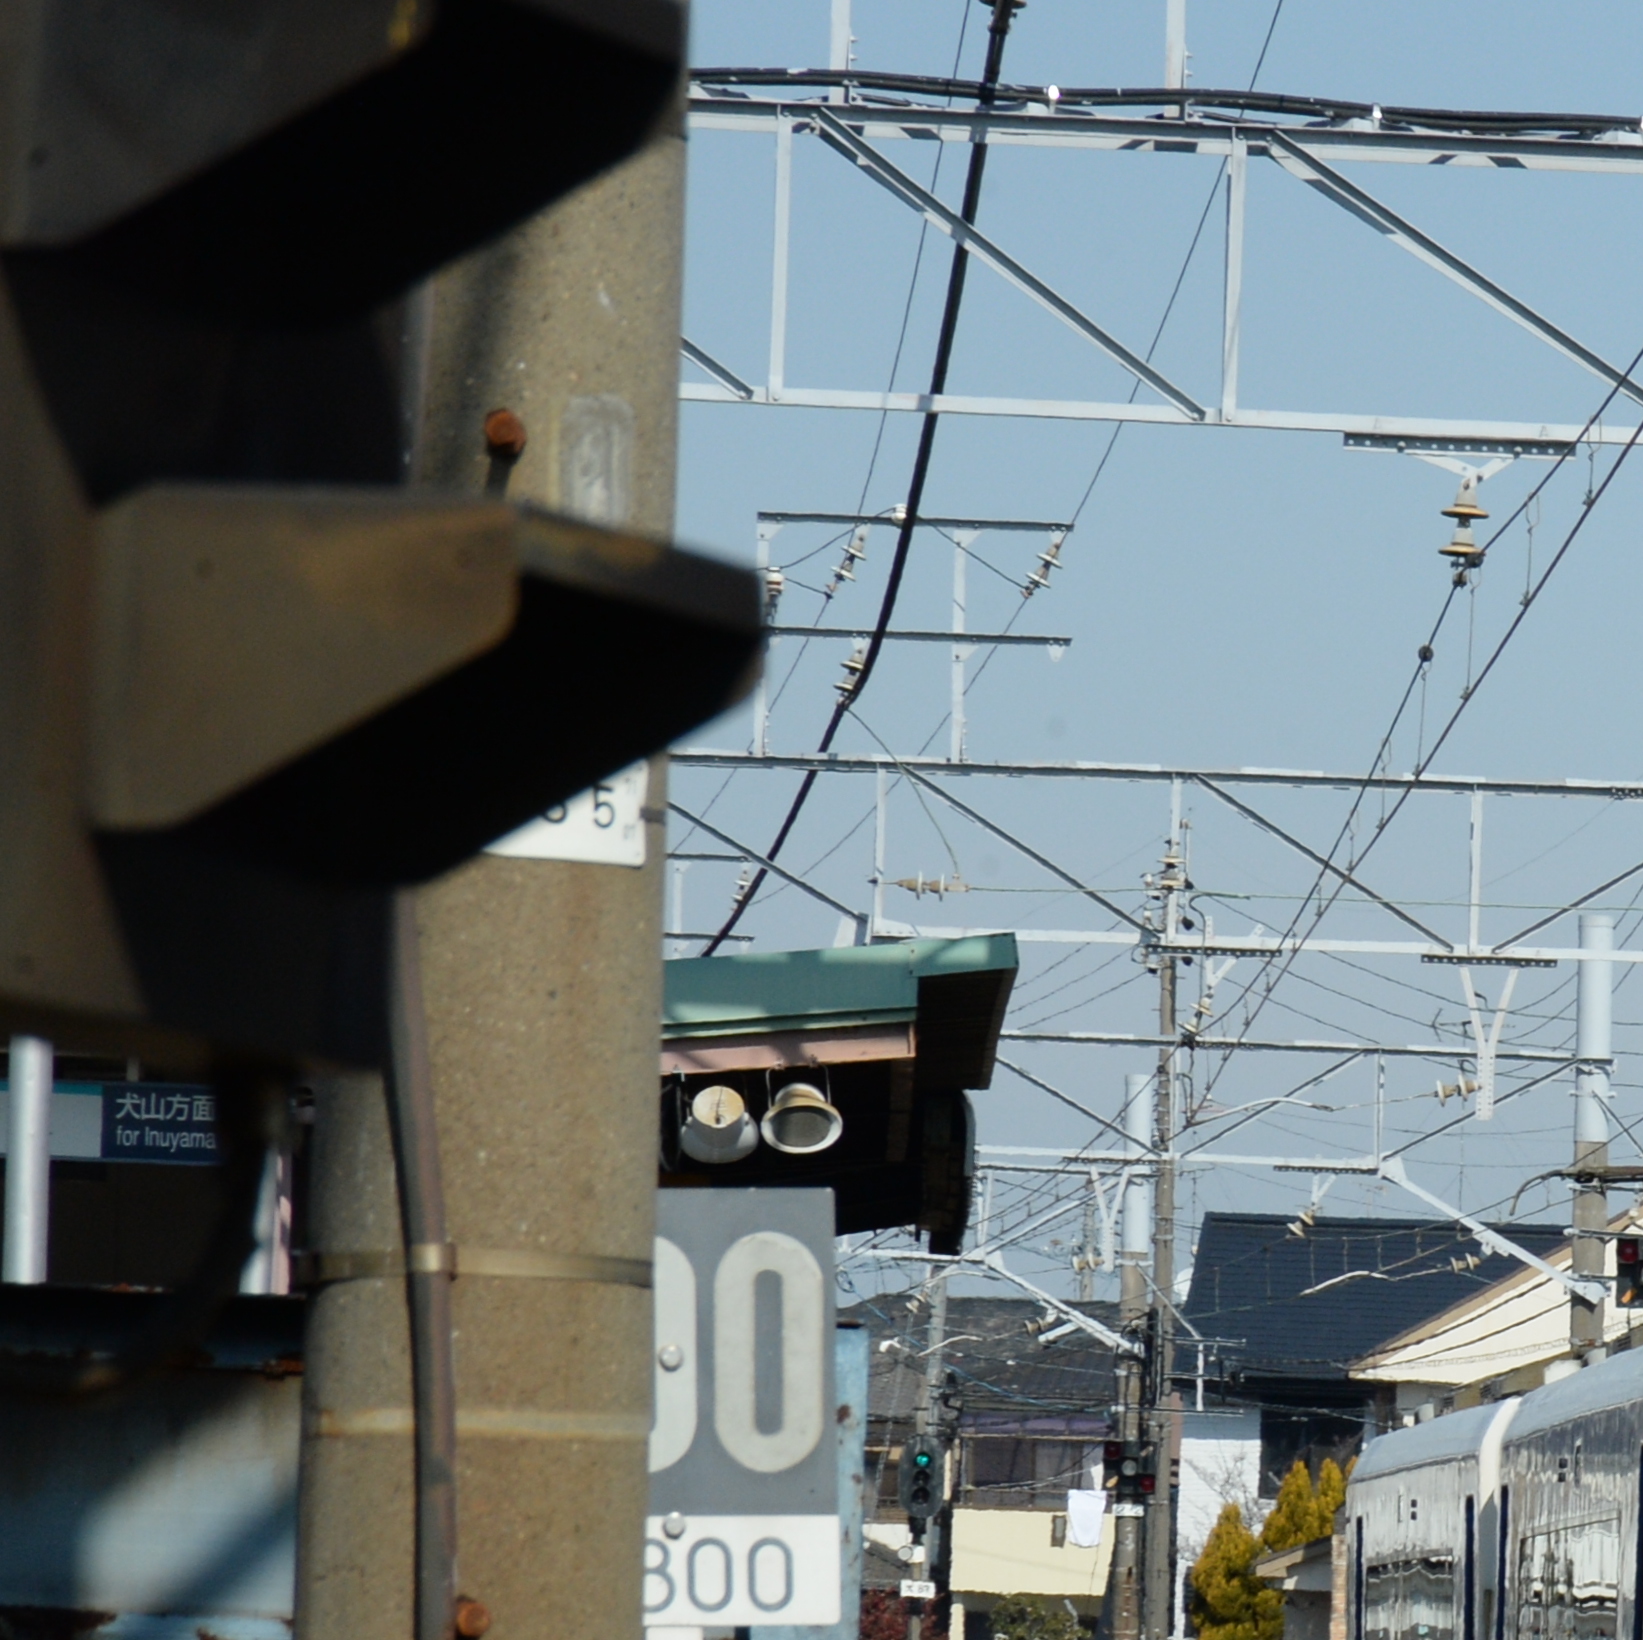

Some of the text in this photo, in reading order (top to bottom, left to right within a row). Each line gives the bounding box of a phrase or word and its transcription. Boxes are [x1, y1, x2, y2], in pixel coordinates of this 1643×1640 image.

[115, 1092, 217, 1121] 犬山方面
[117, 1125, 217, 1153] for Inuyama
